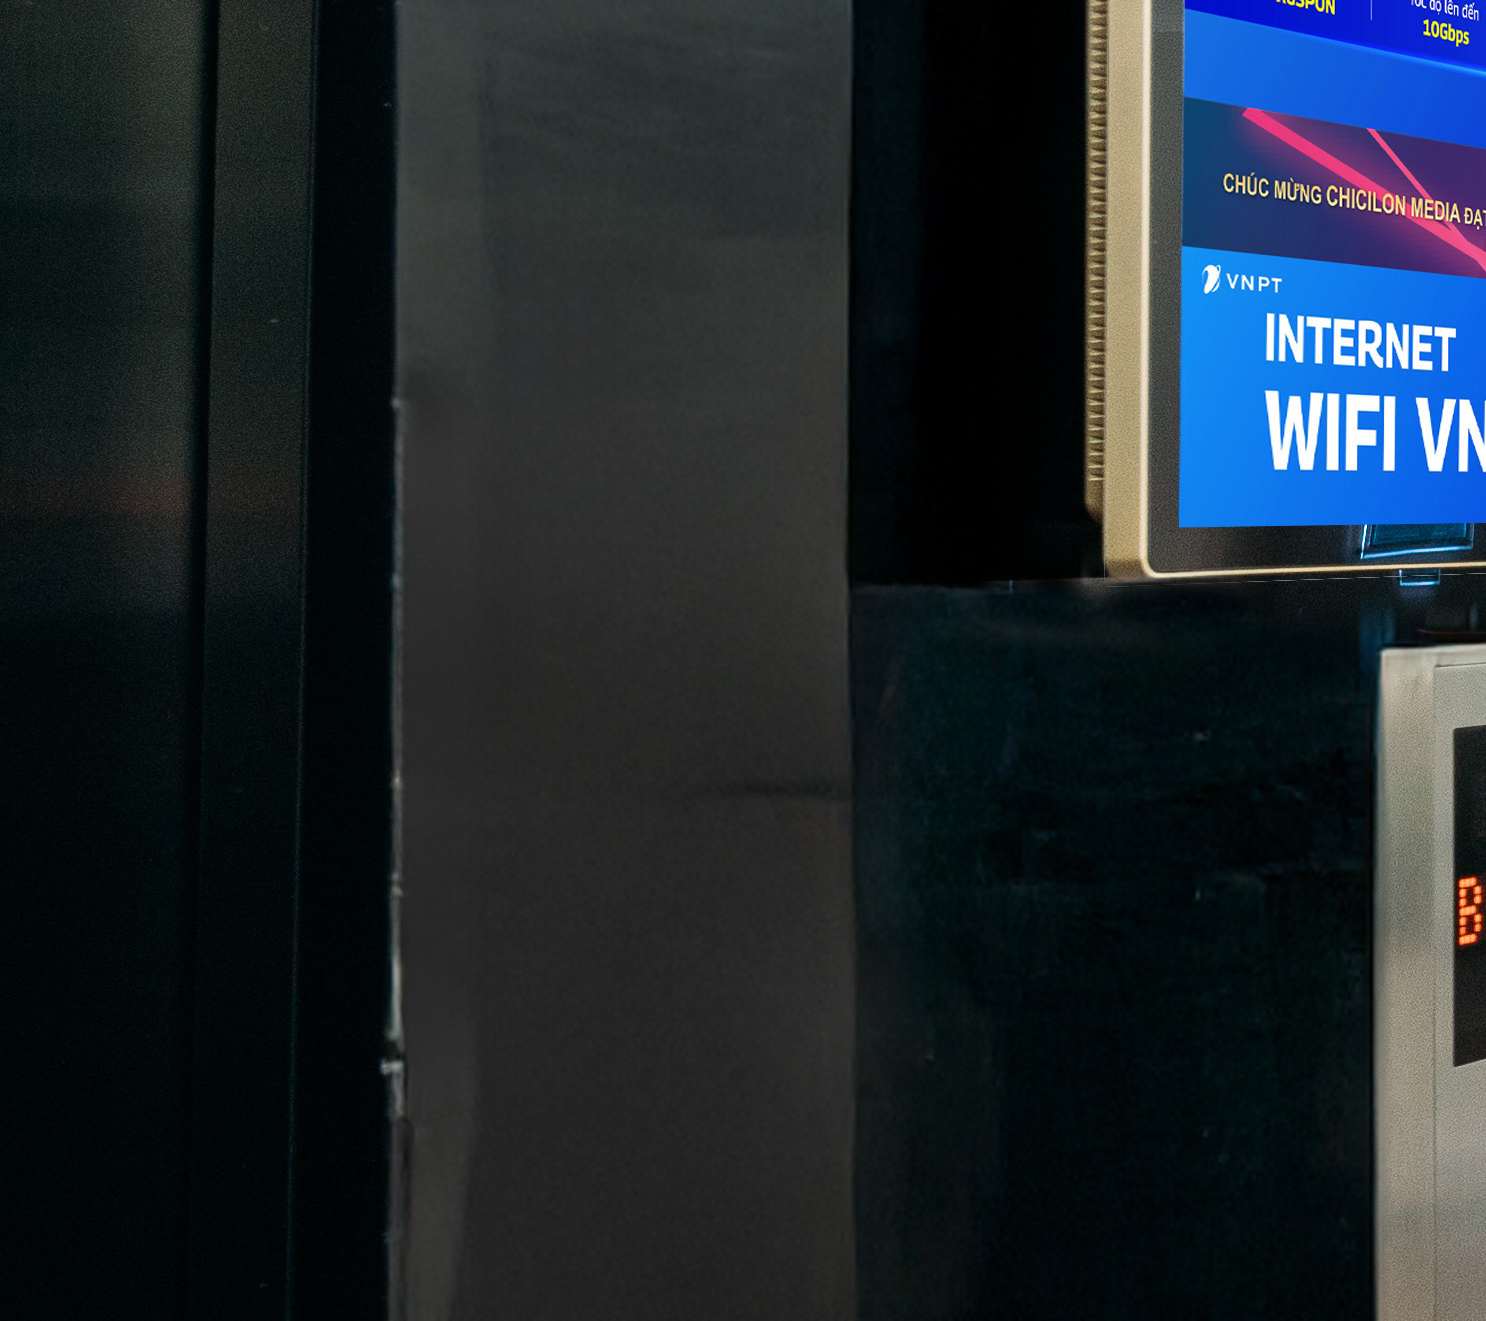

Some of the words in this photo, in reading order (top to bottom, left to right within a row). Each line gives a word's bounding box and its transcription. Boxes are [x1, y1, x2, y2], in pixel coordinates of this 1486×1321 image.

[1462, 3, 1479, 21] đến
[1423, 19, 1470, 47] 10Gbps
[1223, 172, 1269, 198] CHÚC
[1274, 178, 1322, 205] MỪNG
[1326, 185, 1406, 216] CHICILON
[1411, 197, 1461, 224] MEDIA
[1226, 273, 1282, 293] VNPT
[1266, 313, 1457, 371] INTERNET
[1265, 390, 1396, 471] WIFI
